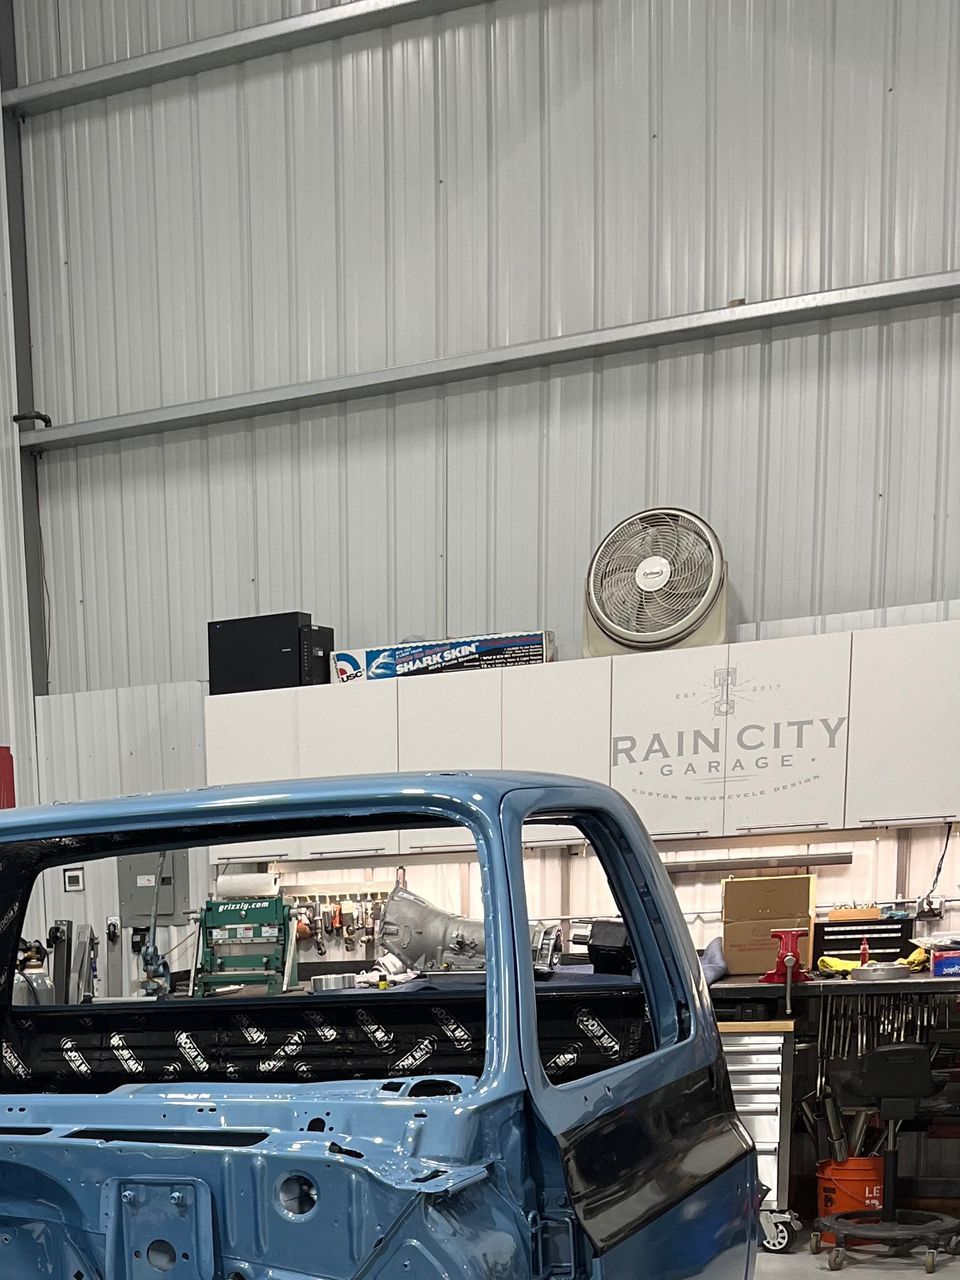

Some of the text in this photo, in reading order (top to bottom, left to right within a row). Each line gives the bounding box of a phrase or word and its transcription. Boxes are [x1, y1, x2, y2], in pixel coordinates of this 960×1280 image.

[396, 652, 442, 675] SHARK
[442, 644, 476, 660] SKIN
[341, 671, 363, 683] USC
[675, 692, 697, 700] EST
[751, 684, 782, 692] 2017
[612, 717, 847, 767] RAIN CITY
[660, 754, 793, 777] GARAGE
[632, 774, 821, 801] CUSTOM MOTORCYCLE DESIGN
[218, 901, 269, 912] grizzly.com
[413, 1040, 434, 1059] MAT
